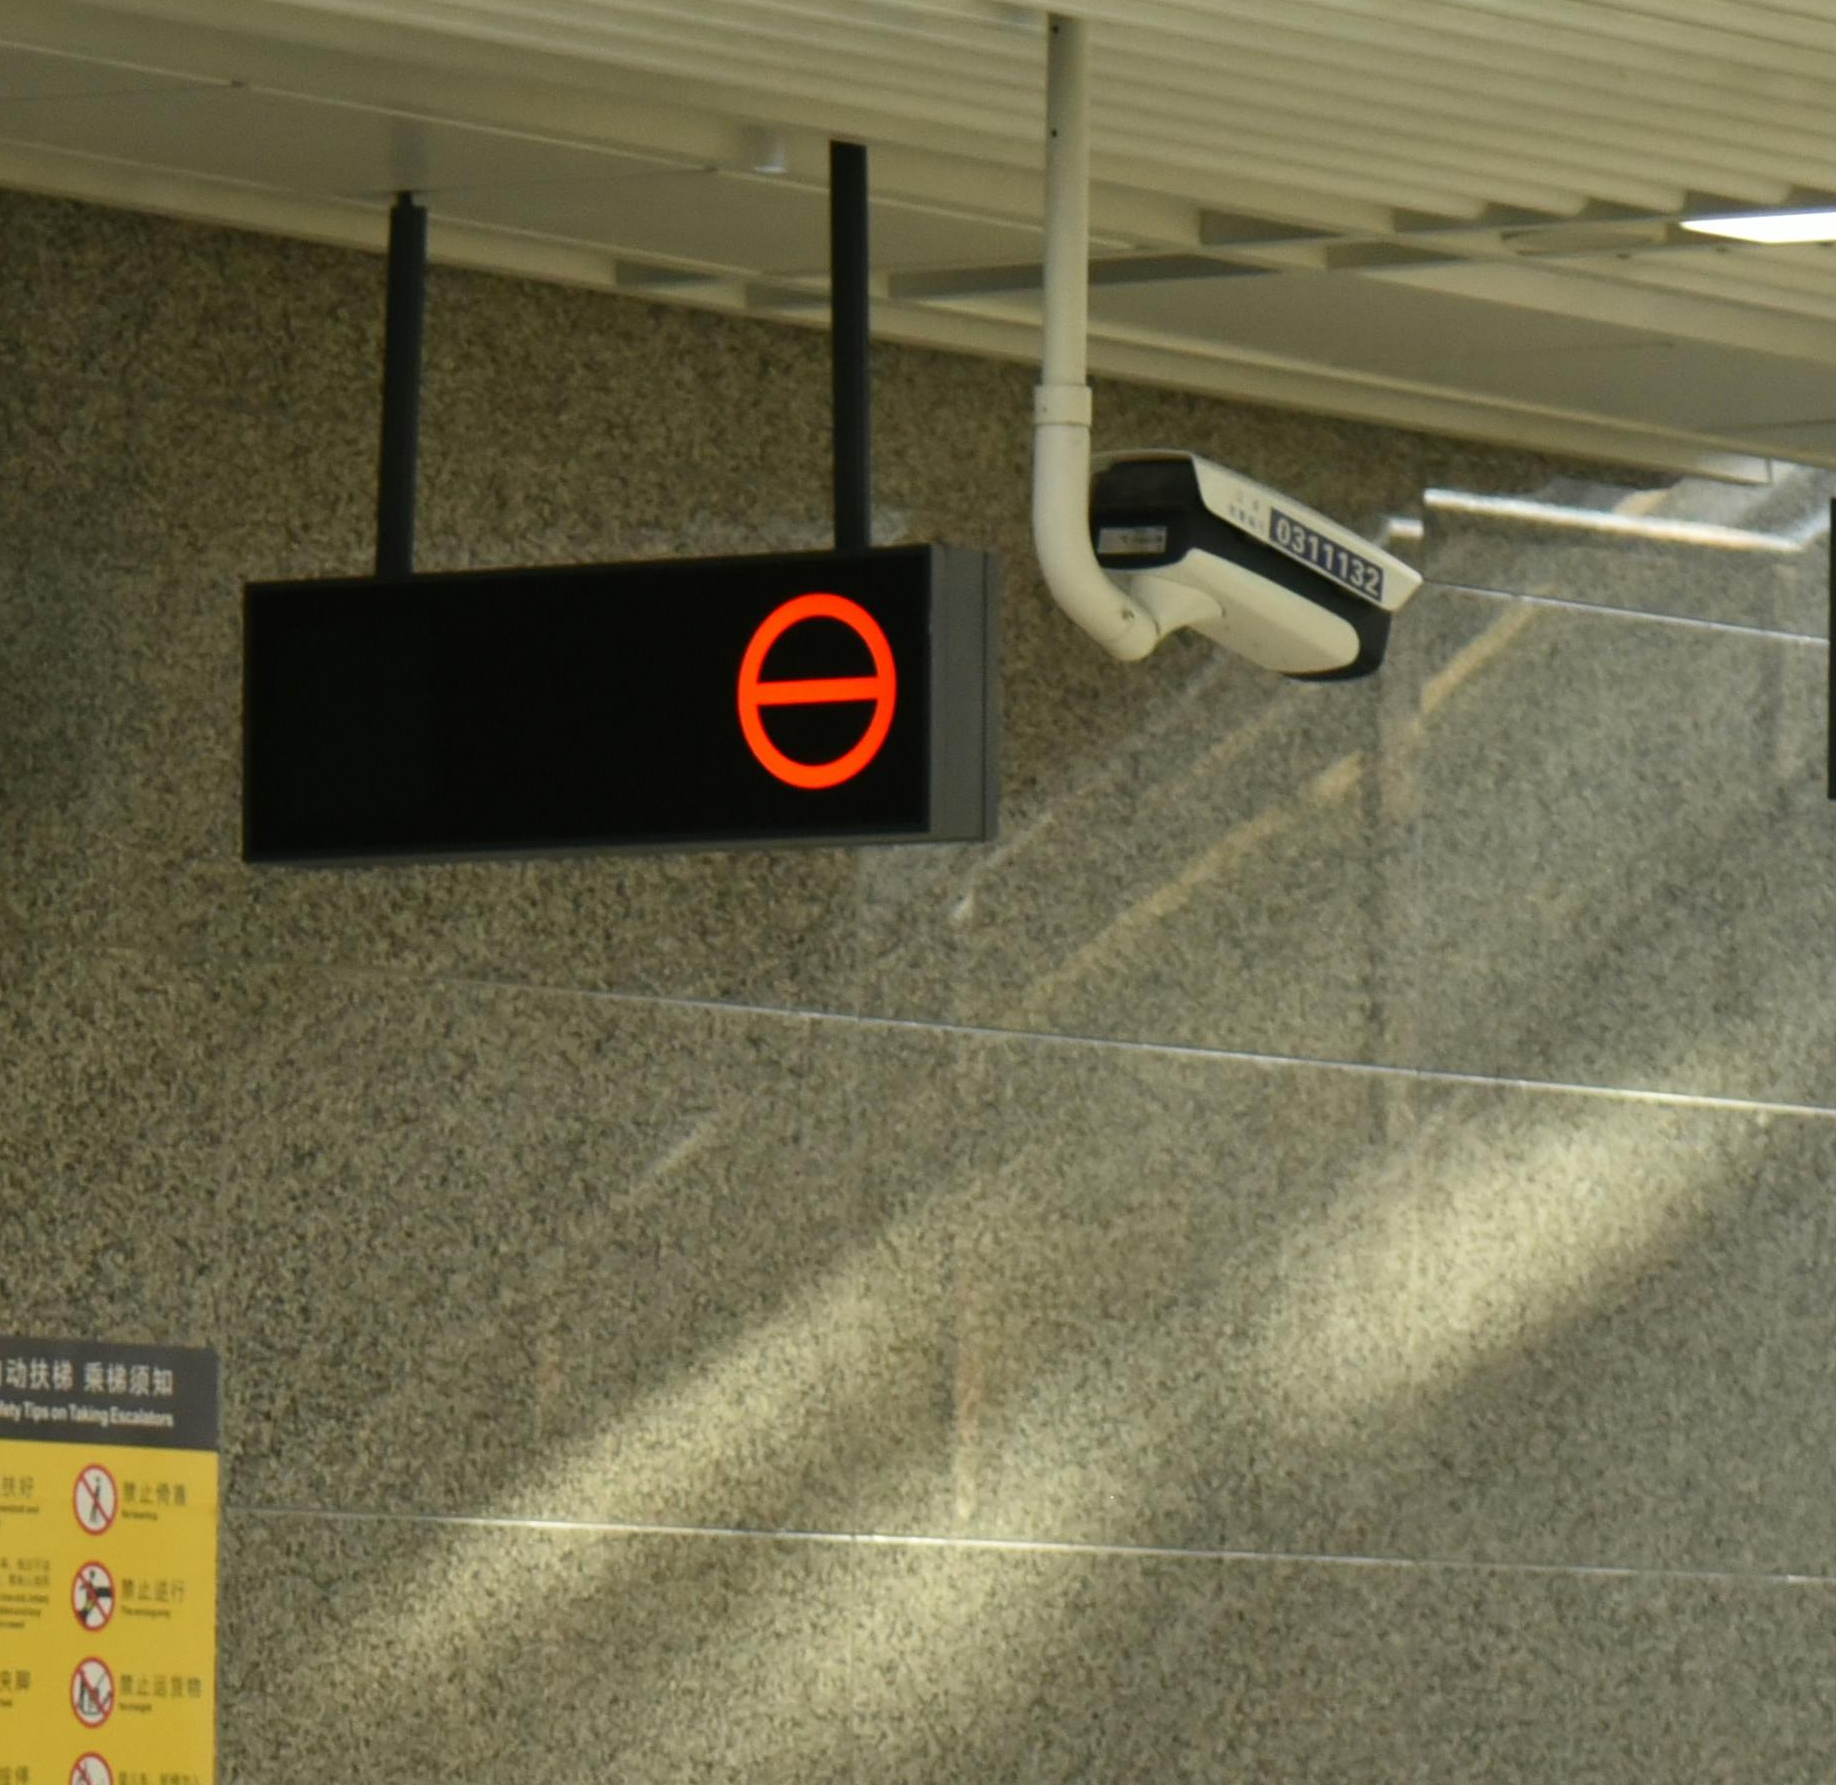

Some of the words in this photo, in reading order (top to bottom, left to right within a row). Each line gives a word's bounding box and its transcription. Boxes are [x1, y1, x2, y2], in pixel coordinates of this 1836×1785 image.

[1275, 518, 1380, 596] 0311132
[0, 1357, 73, 1391] 动扶梯
[22, 1400, 49, 1424] Tips
[51, 1407, 68, 1420] on
[68, 1403, 108, 1427] Taking
[109, 1406, 174, 1427] Escalators
